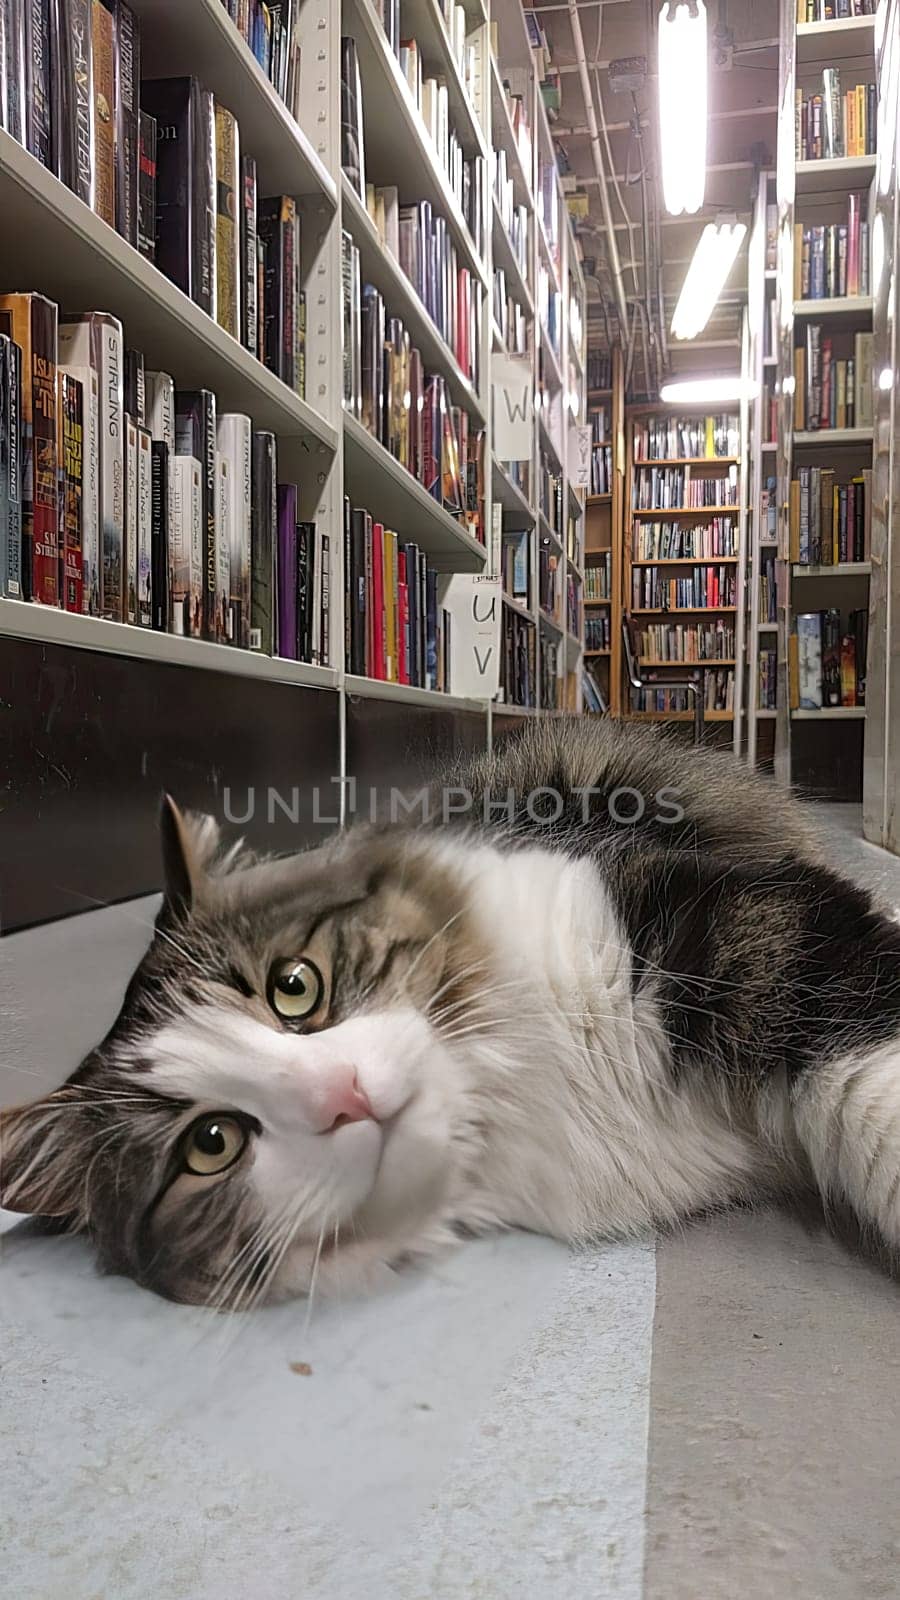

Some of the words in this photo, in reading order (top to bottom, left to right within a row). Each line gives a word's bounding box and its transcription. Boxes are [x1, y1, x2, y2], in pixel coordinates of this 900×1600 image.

[108, 337, 120, 438] STIRLING
[503, 385, 529, 423] W
[207, 406, 217, 489] STIRLING
[578, 431, 589, 444] X
[10, 424, 18, 499] STIRLING
[579, 447, 589, 465] Y
[472, 594, 496, 623] U
[473, 646, 493, 675] V
